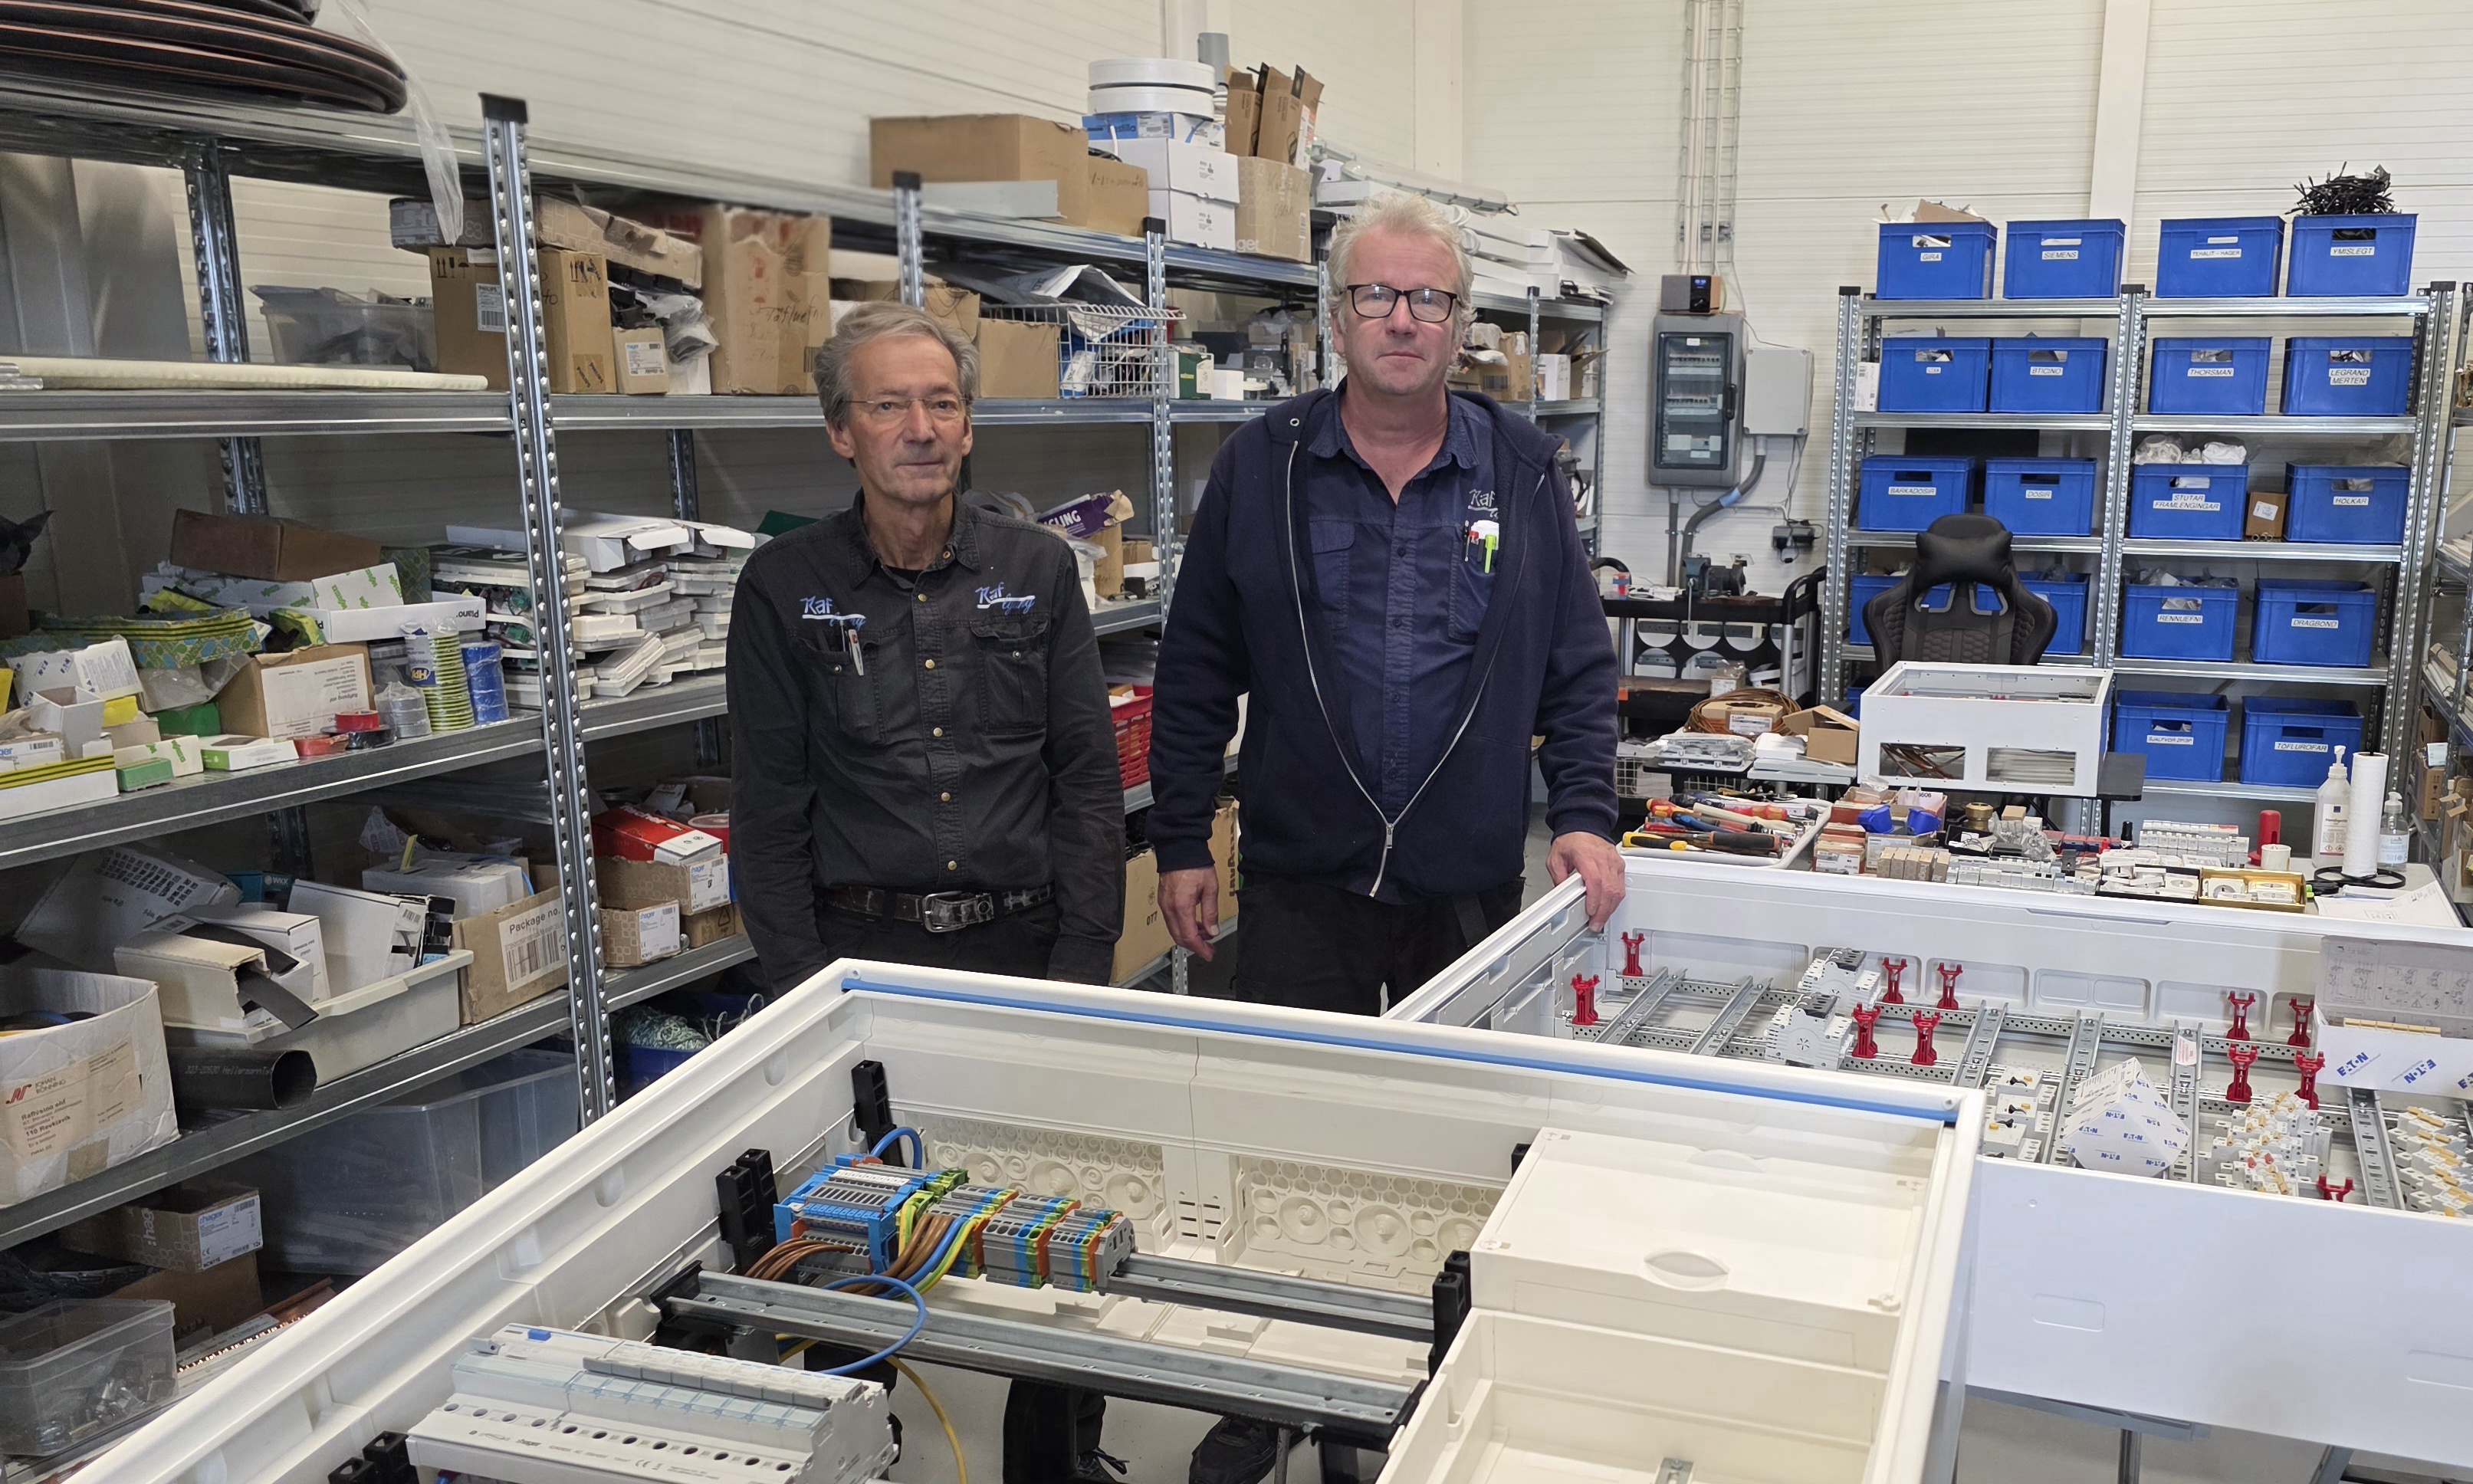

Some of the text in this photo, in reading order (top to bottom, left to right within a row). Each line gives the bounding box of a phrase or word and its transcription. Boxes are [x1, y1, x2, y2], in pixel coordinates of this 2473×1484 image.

[2043, 251, 2077, 259] SIEMENS
[1470, 489, 1496, 507] Raf
[975, 582, 1004, 604] Raf
[800, 596, 833, 614] Raf
[458, 609, 480, 619] Piano
[2159, 615, 2202, 623] RENNUEFNI
[2292, 619, 2337, 628] DRAGBOND
[509, 908, 561, 935] Package no.
[25, 1128, 38, 1137] 110
